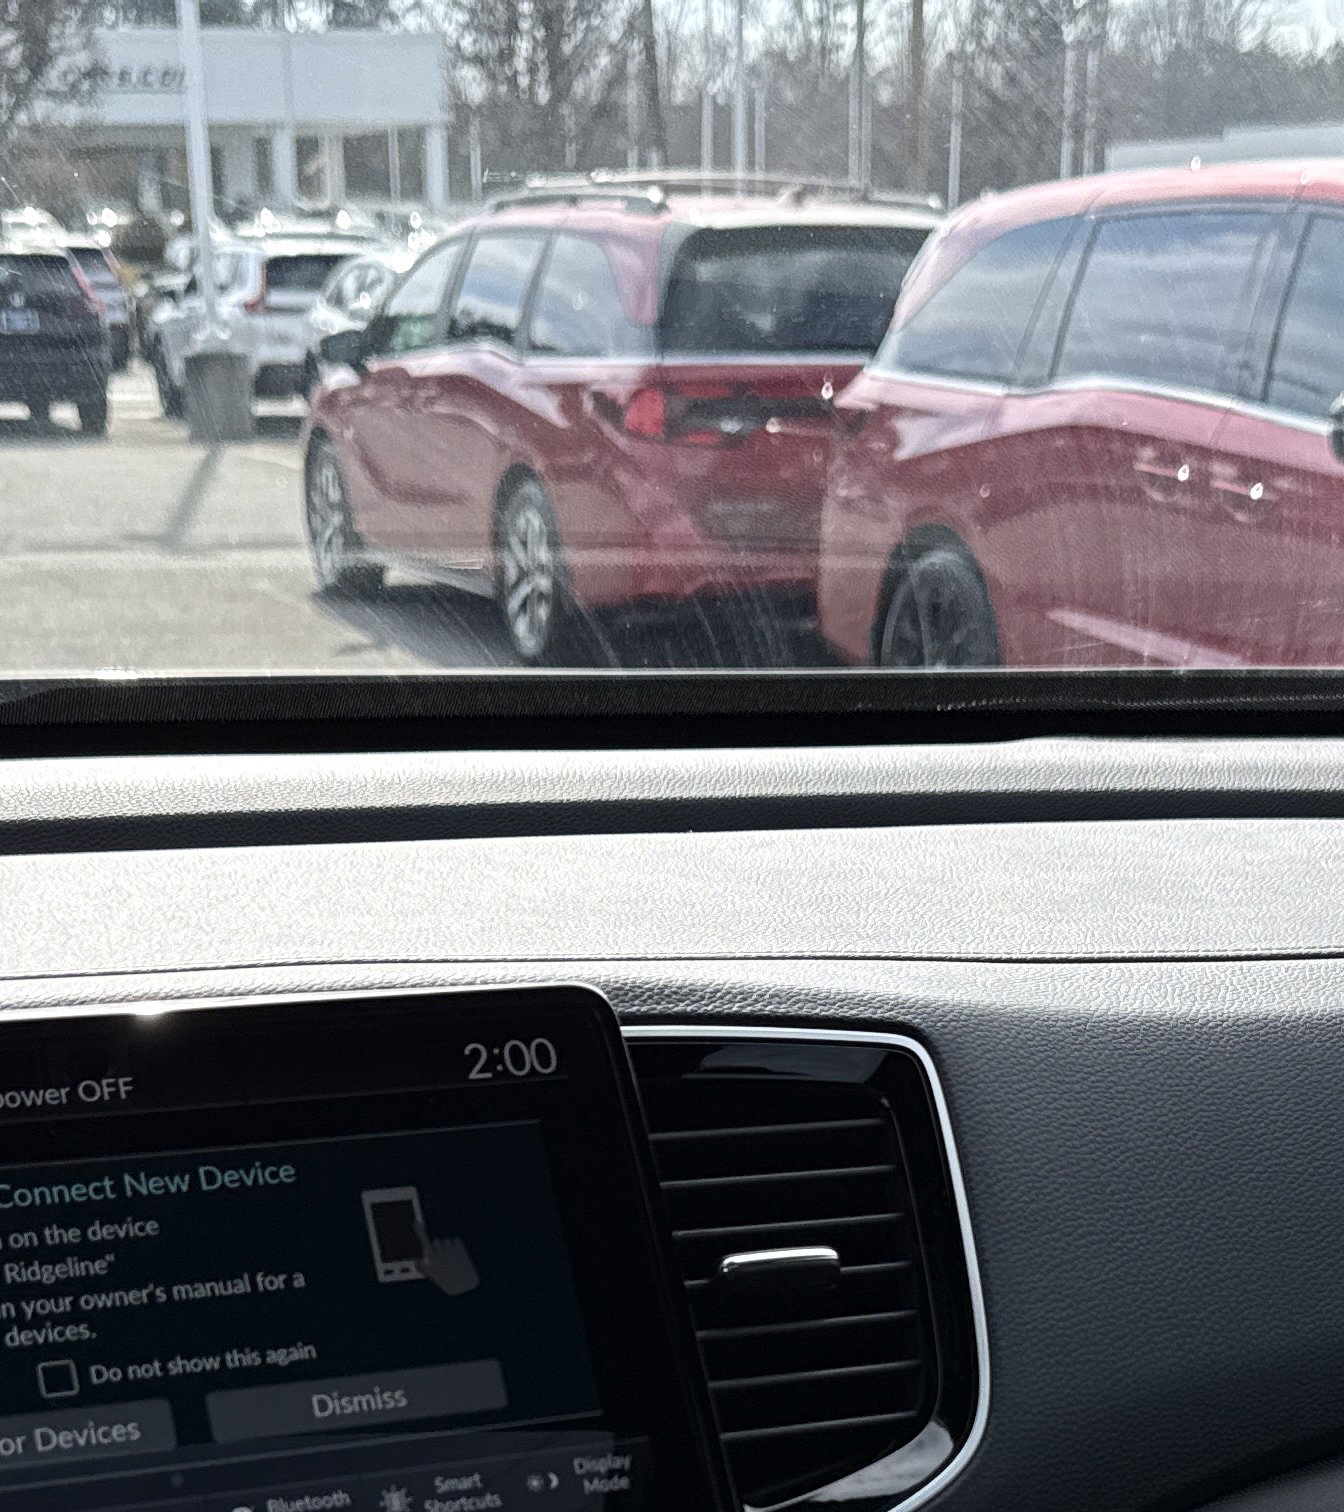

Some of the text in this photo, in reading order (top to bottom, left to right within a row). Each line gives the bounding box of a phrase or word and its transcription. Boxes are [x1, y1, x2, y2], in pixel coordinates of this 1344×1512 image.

[463, 1036, 558, 1081] 2:00
[76, 1076, 136, 1105] OFF
[124, 1167, 191, 1199] New
[198, 1160, 298, 1191] Device
[8, 1228, 39, 1250] on
[44, 1222, 83, 1246] the
[87, 1214, 161, 1243] device
[4, 1252, 116, 1289] Ridgeline"
[20, 1293, 74, 1323] your
[80, 1282, 168, 1313] owner's
[172, 1272, 254, 1301] manual
[256, 1270, 289, 1295] for
[292, 1271, 308, 1288] a
[4, 1320, 98, 1349] devices.
[90, 1341, 317, 1385] Do not show this again
[311, 1386, 408, 1419] Dismiss
[33, 1418, 142, 1455] Devices
[572, 1452, 633, 1476] Display
[433, 1472, 483, 1495] Smart
[582, 1474, 631, 1495] Mode
